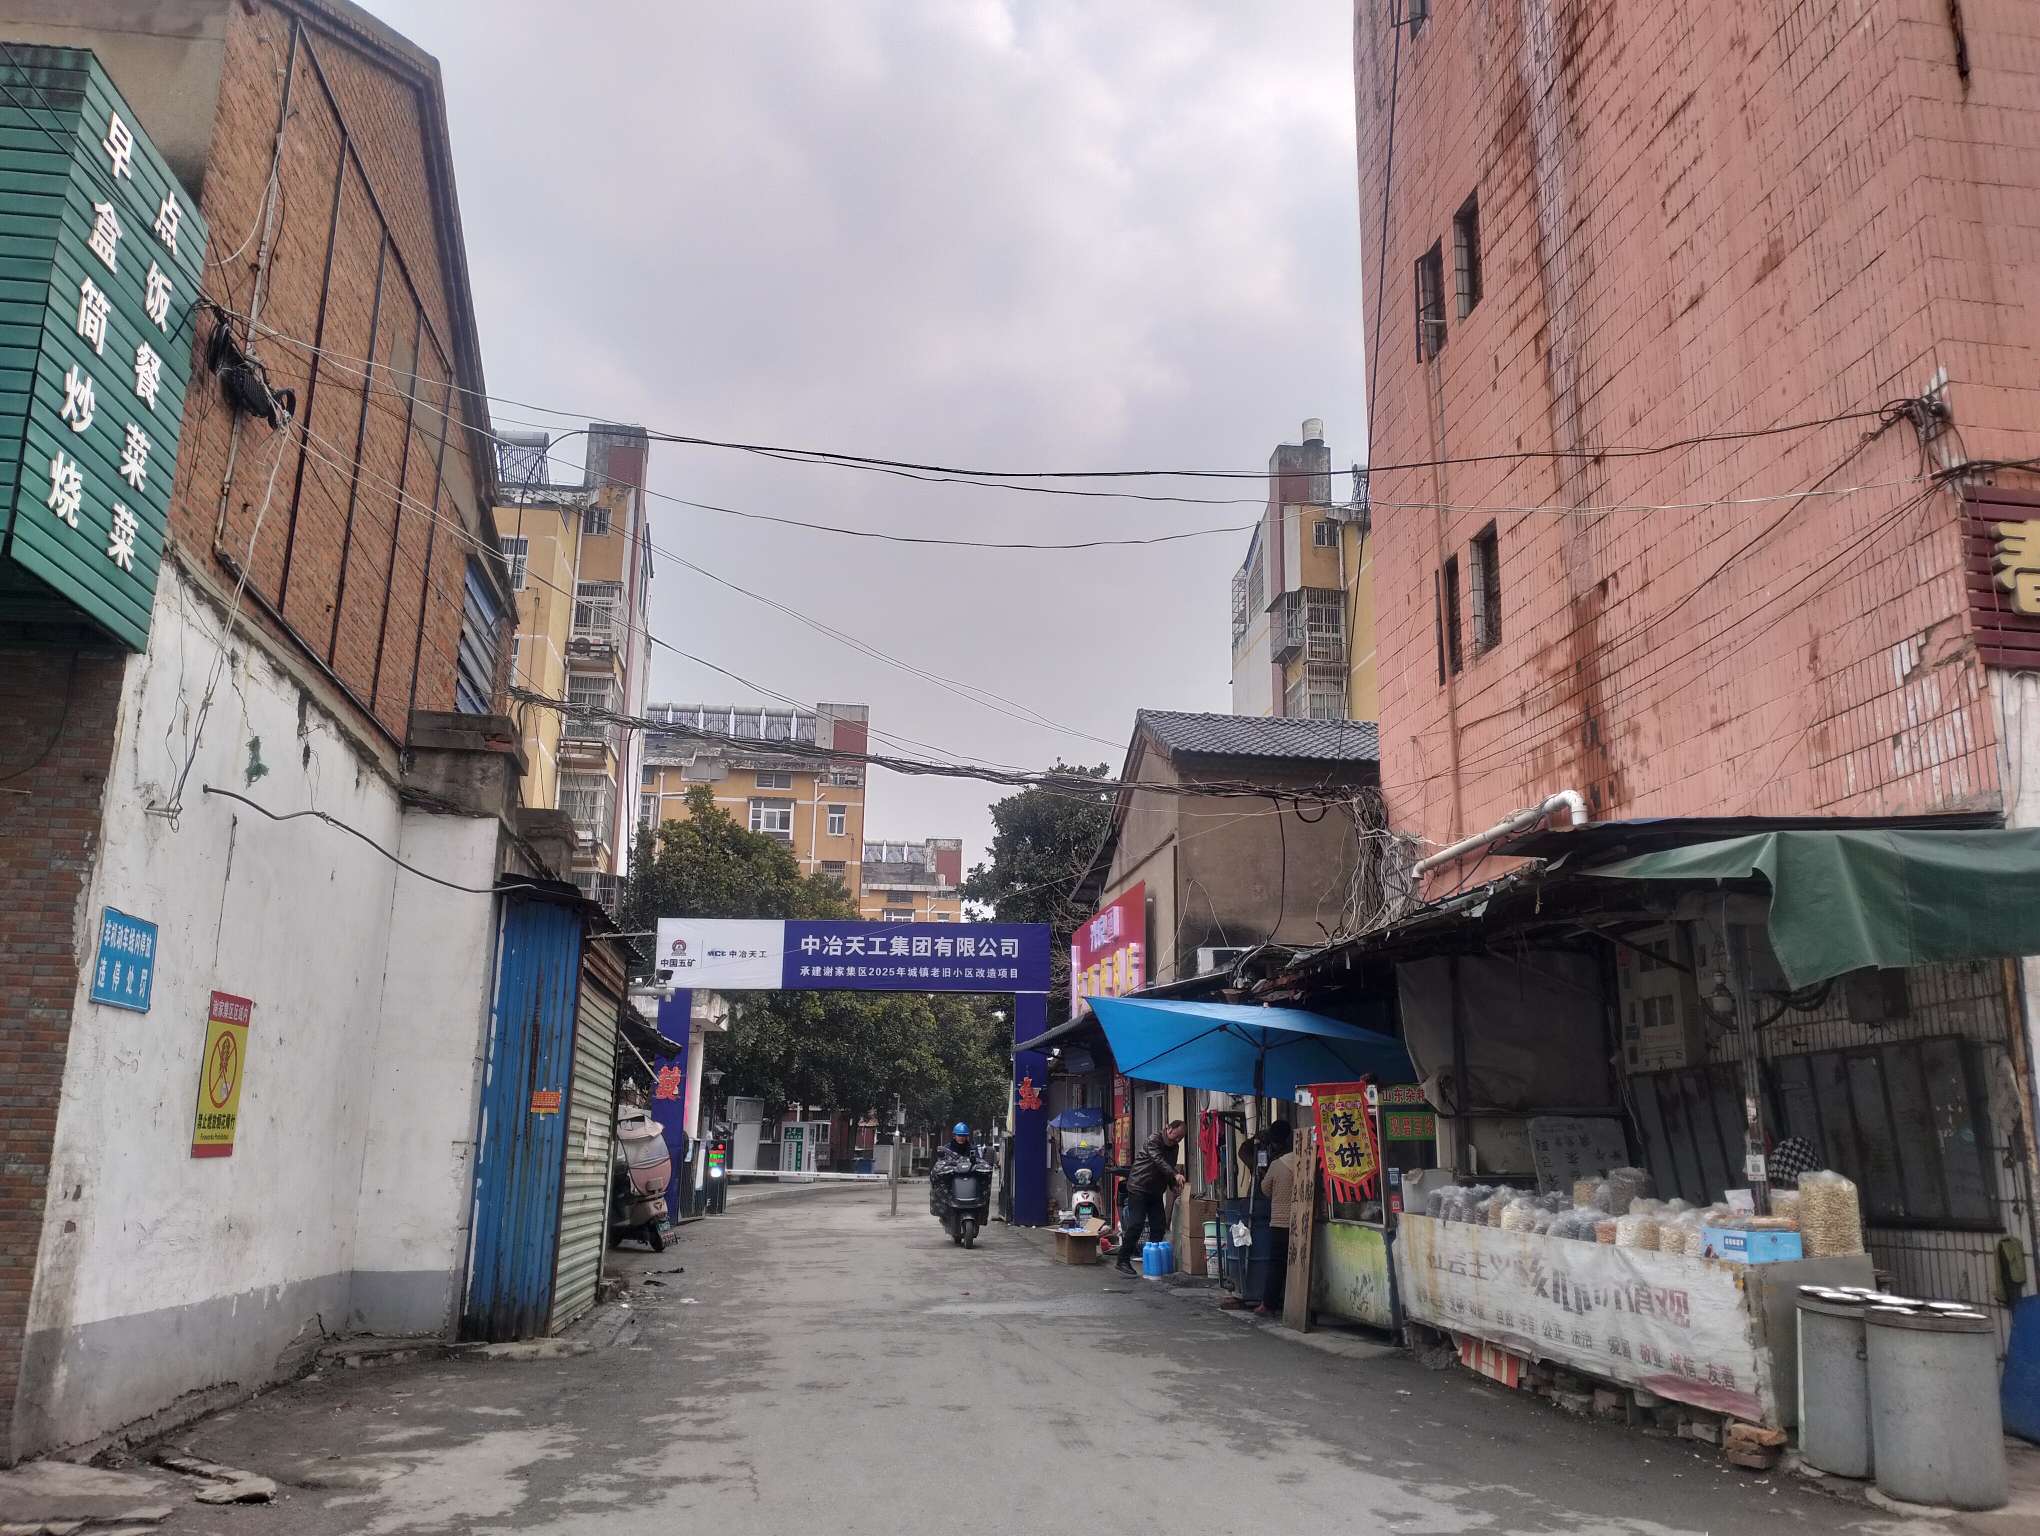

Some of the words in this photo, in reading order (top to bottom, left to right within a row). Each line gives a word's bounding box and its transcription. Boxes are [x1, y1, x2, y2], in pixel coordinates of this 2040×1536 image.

[800, 935, 1020, 958] 中冶天工集团有限公司
[729, 950, 767, 959] 中冶天工
[660, 958, 697, 968] 中国五矿
[800, 965, 1019, 979] 承建谢家集区2025年城镇老旧小区改造项目
[1331, 1112, 1365, 1168] 烧饼
